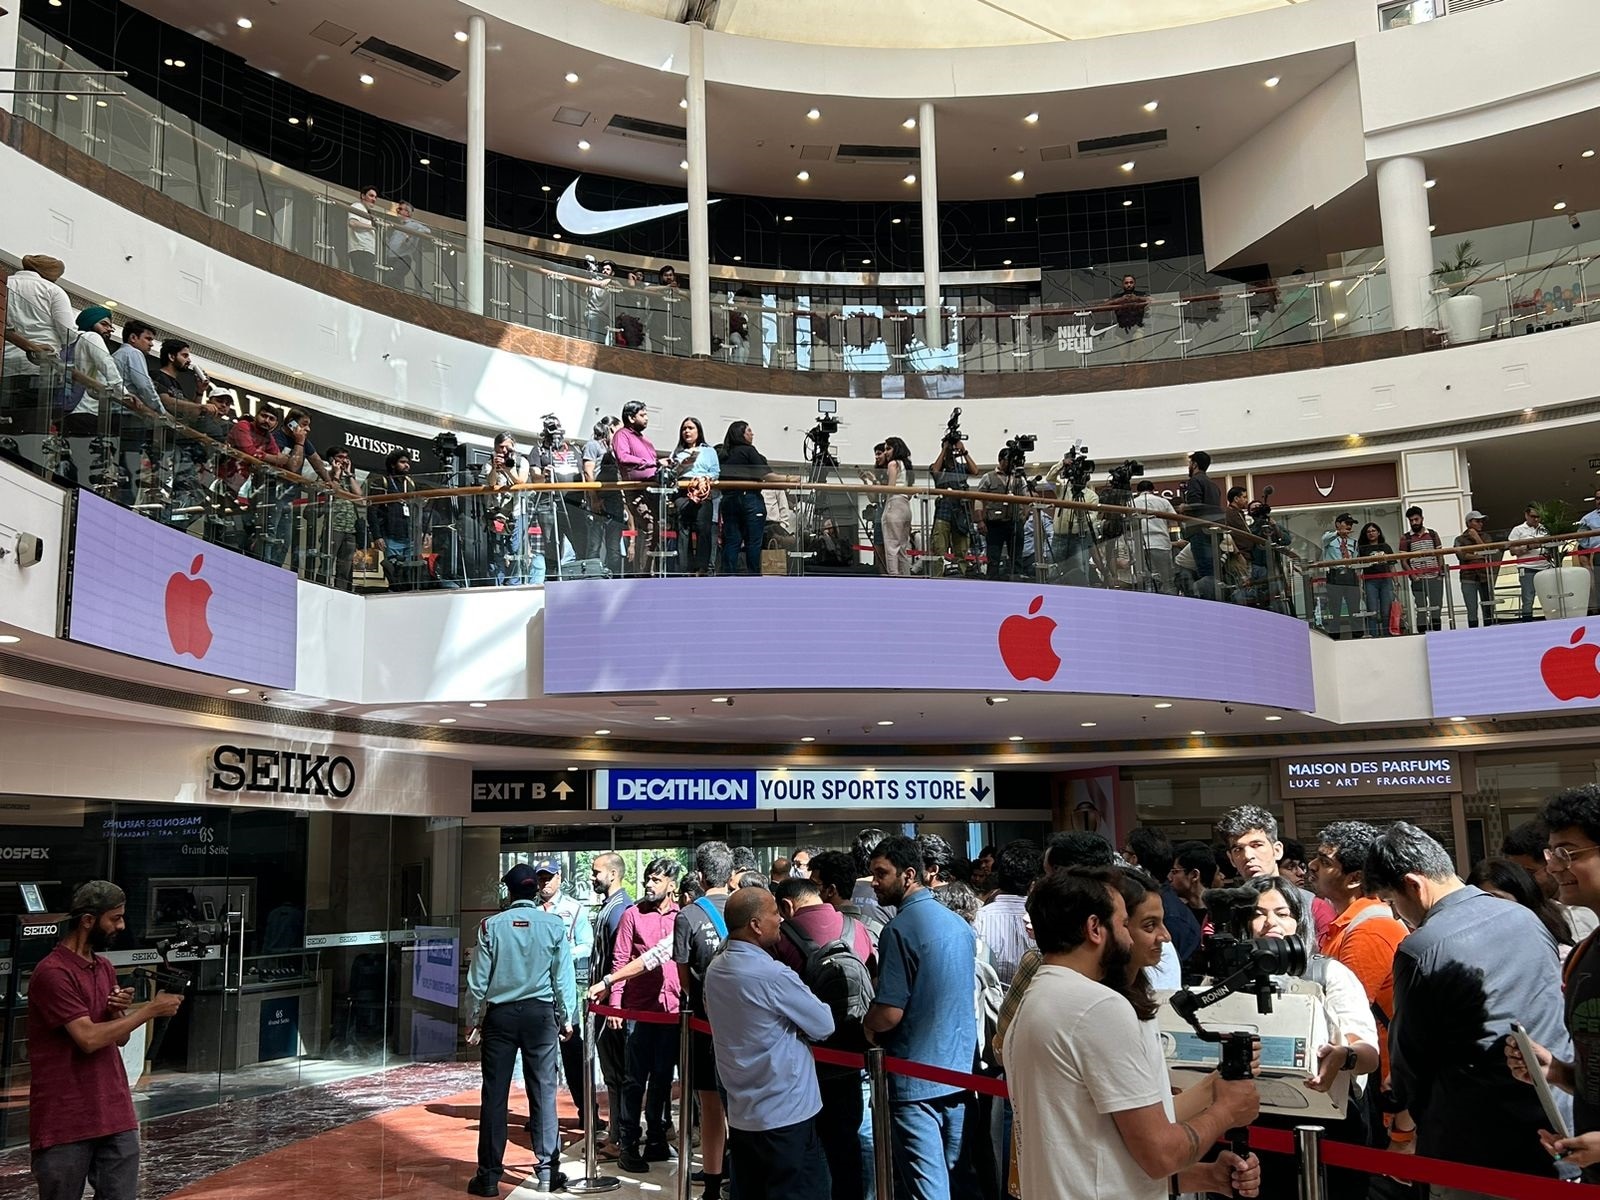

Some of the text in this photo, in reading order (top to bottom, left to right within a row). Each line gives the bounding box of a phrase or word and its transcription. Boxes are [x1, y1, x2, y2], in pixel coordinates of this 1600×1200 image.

[1057, 325, 1087, 338] NIKE
[1058, 337, 1094, 351] DELHI
[345, 432, 421, 463] PATISSEE
[212, 744, 356, 799] SEIKO
[1288, 759, 1451, 775] MAISON DES PARFUMS
[617, 778, 748, 801] DECATHLON
[761, 778, 966, 800] YOUR SPORTS STORE
[1289, 775, 1452, 788] LUXE ART FRAGRANCE
[473, 782, 546, 800] EXIT B
[181, 844, 206, 855] Grand
[23, 925, 58, 936] SEIKO
[132, 952, 158, 961] SEIKO
[1201, 984, 1230, 1004] RONIN
